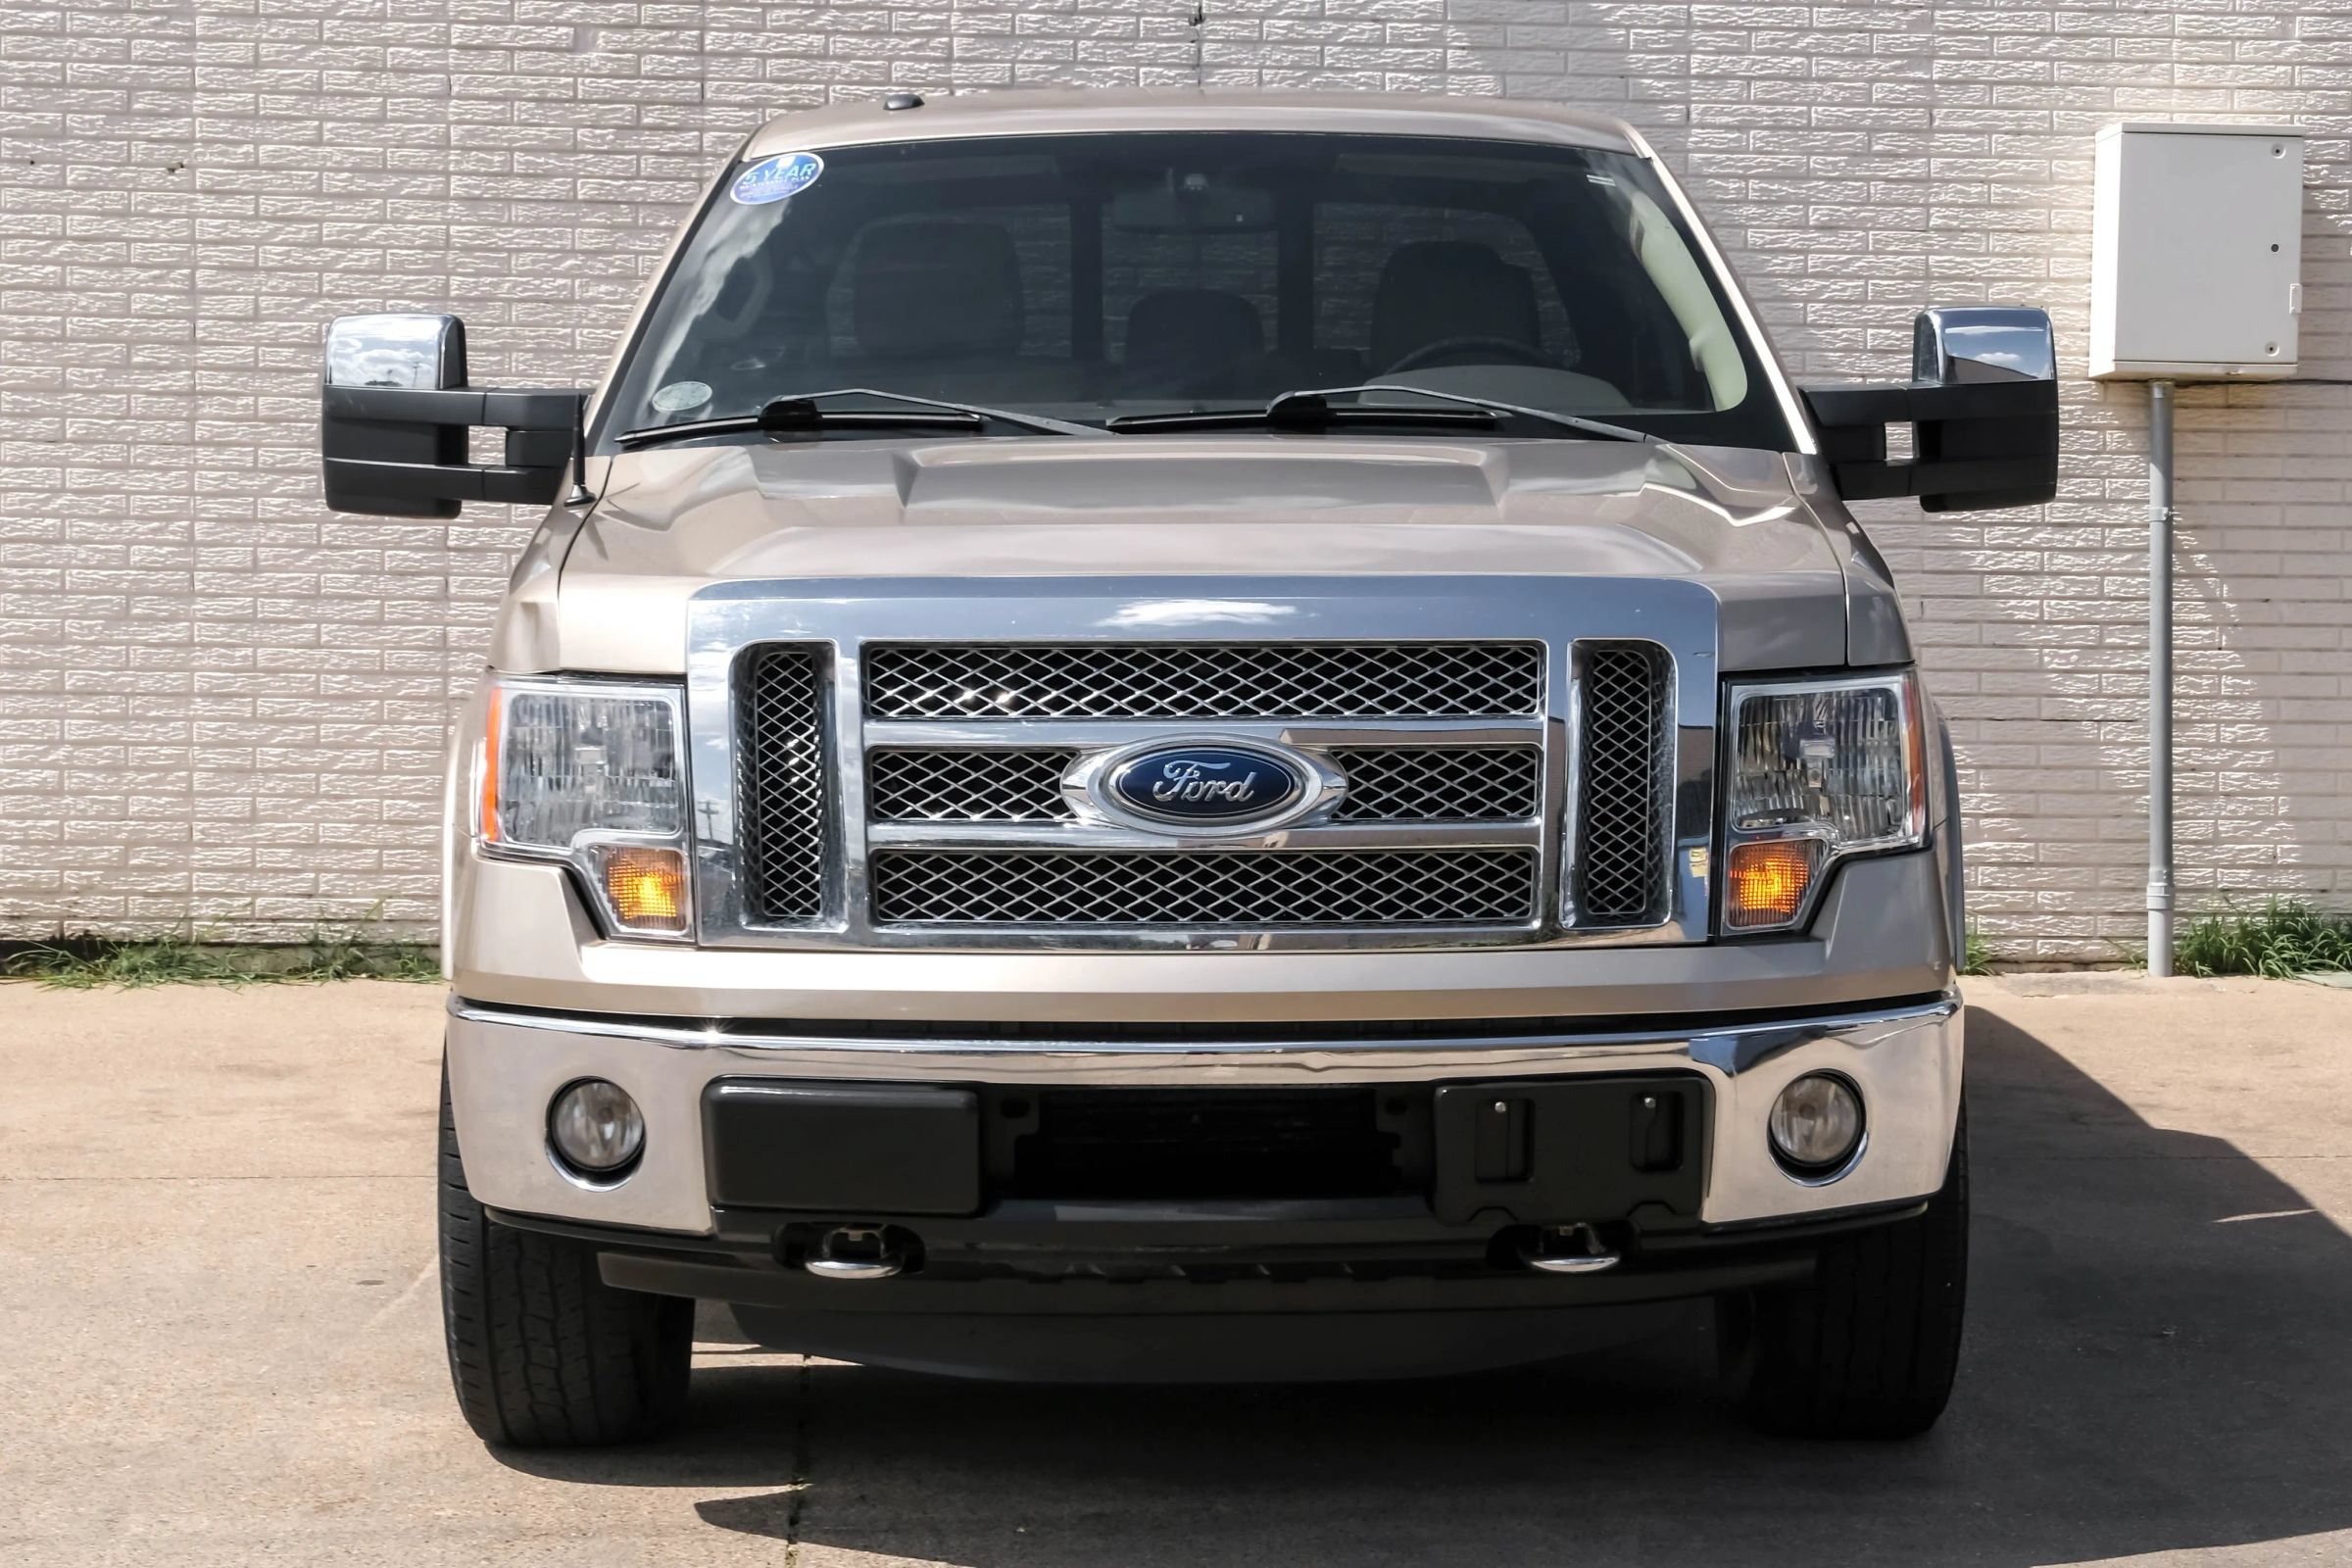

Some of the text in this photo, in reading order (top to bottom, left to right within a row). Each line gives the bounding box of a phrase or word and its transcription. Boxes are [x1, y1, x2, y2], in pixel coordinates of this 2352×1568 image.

[743, 171, 760, 184] 5
[763, 163, 816, 181] YEAR
[1152, 760, 1256, 803] Ford
